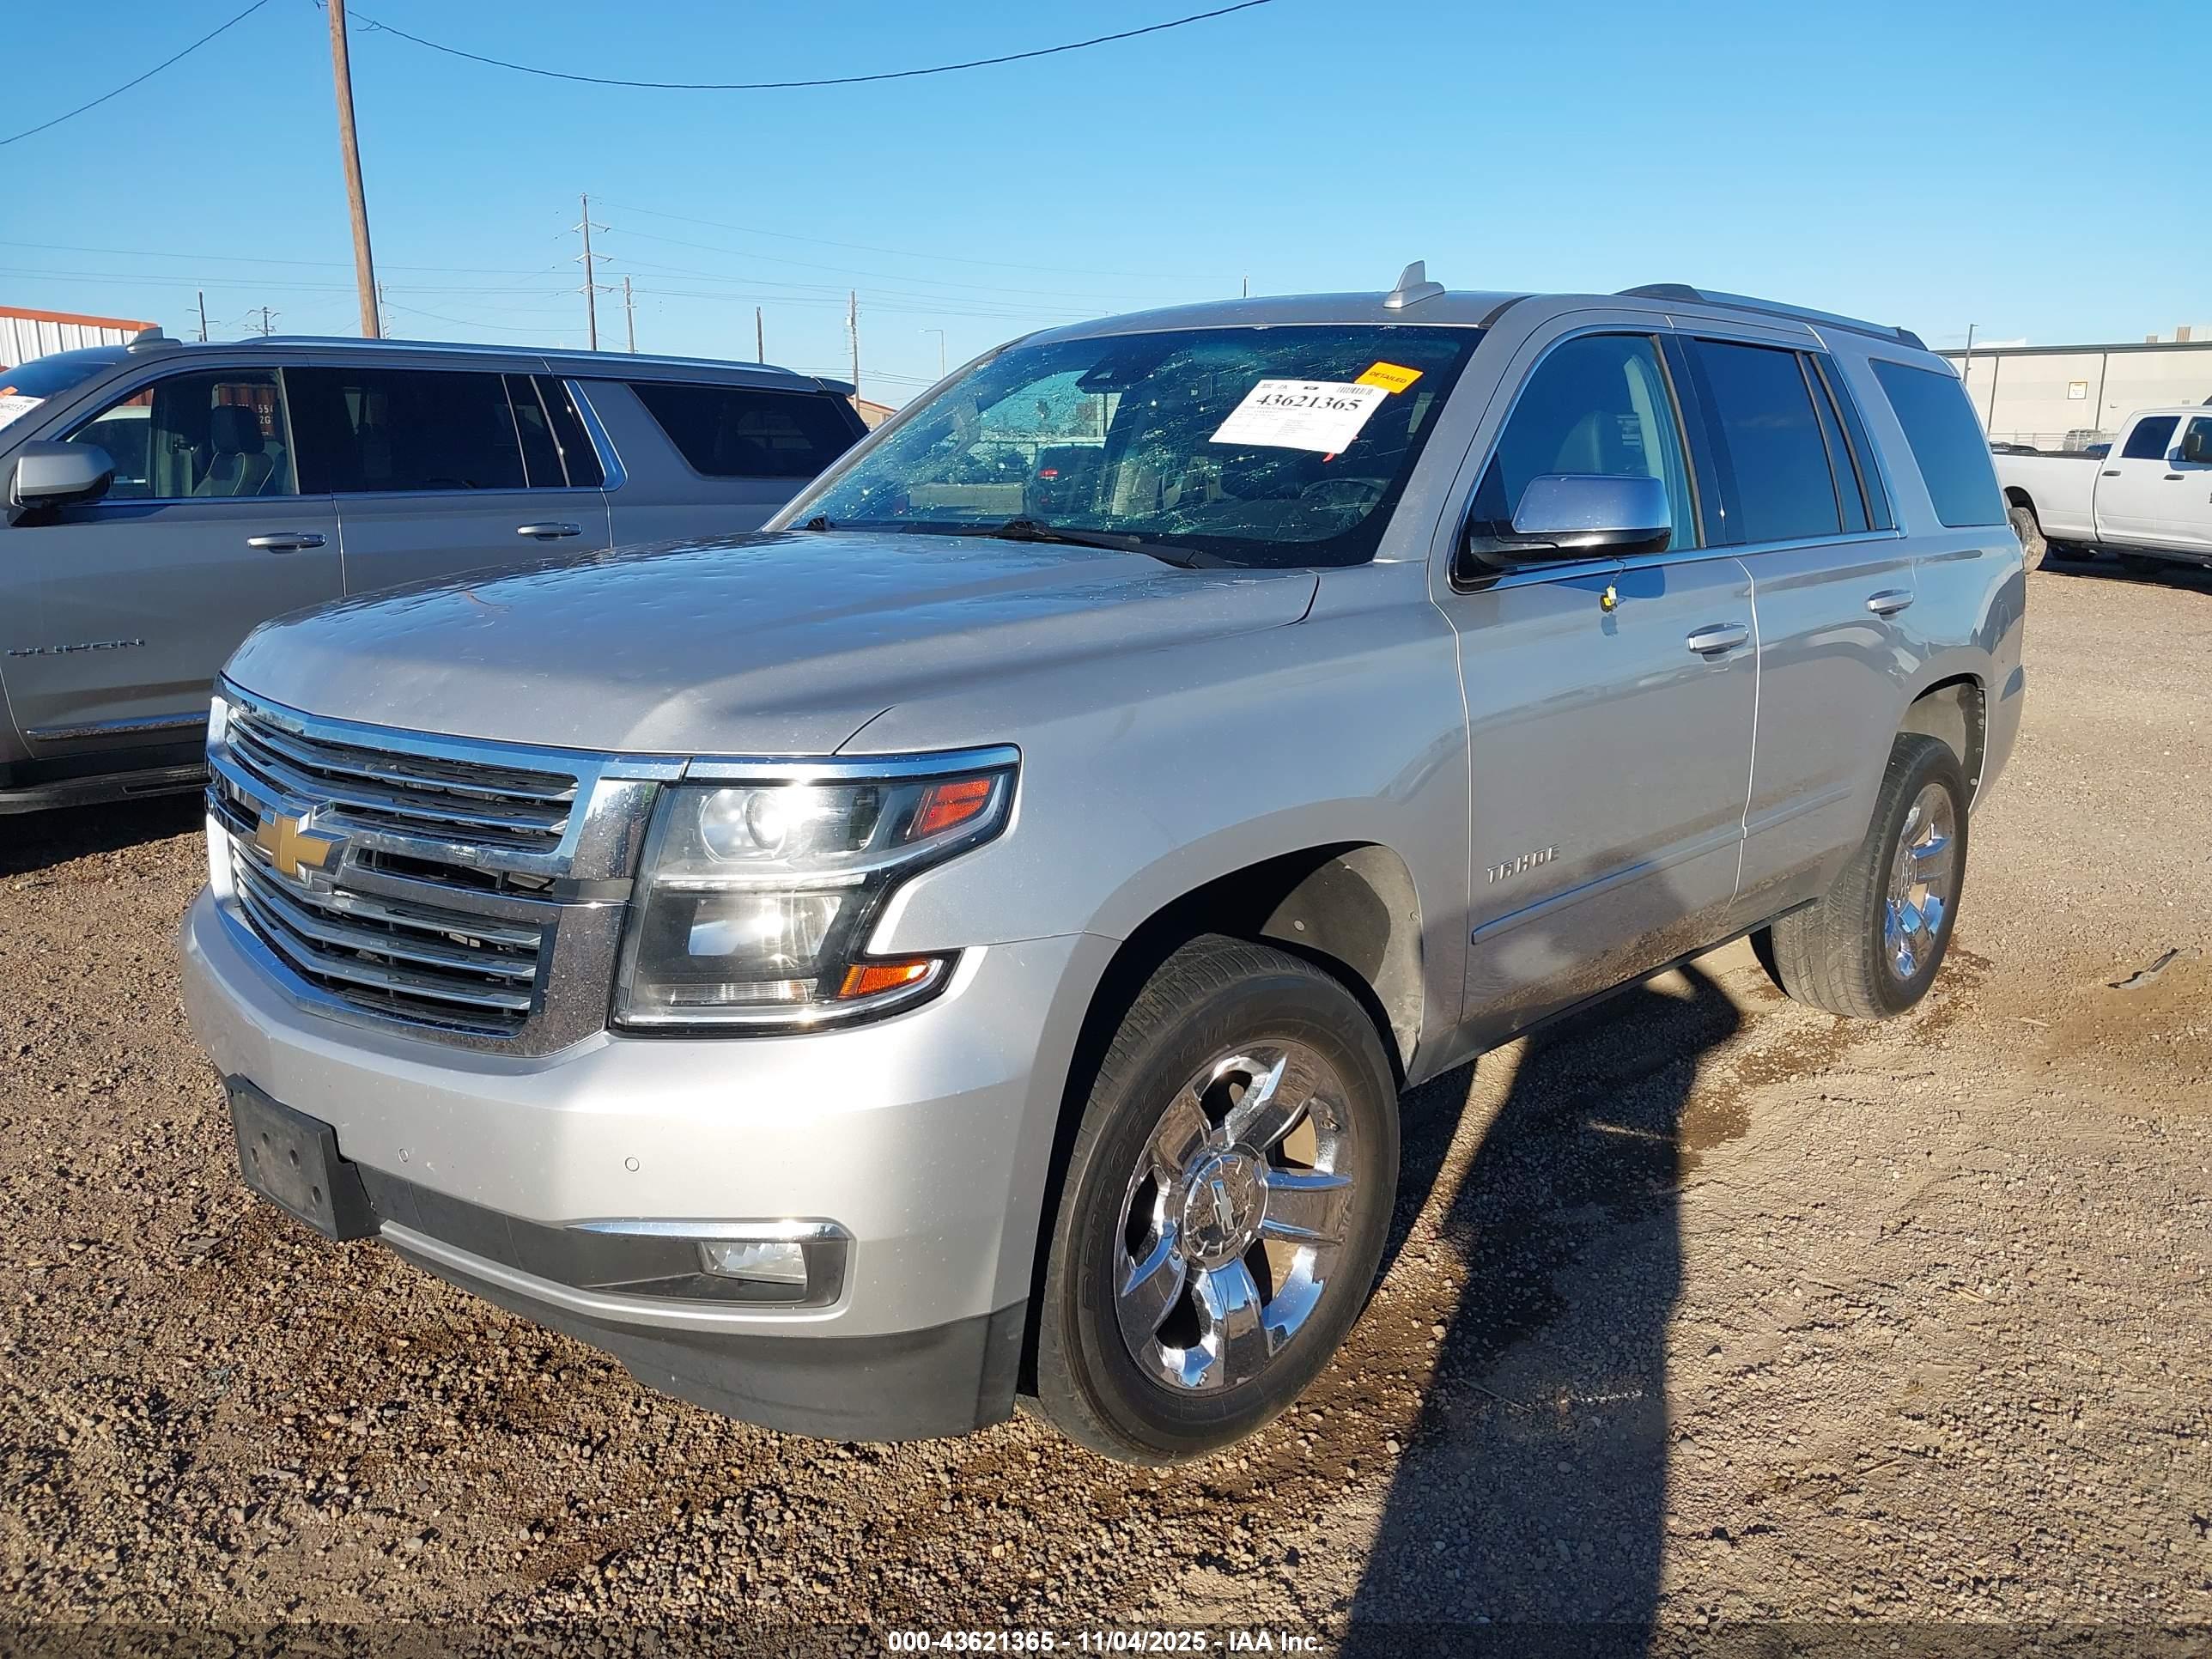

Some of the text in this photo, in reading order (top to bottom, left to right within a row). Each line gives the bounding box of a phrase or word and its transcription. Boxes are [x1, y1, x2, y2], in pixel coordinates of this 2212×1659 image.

[1369, 371, 1407, 384] DETAILED
[1257, 394, 1363, 411] 43621365
[1486, 844, 1560, 884] TAHOE
